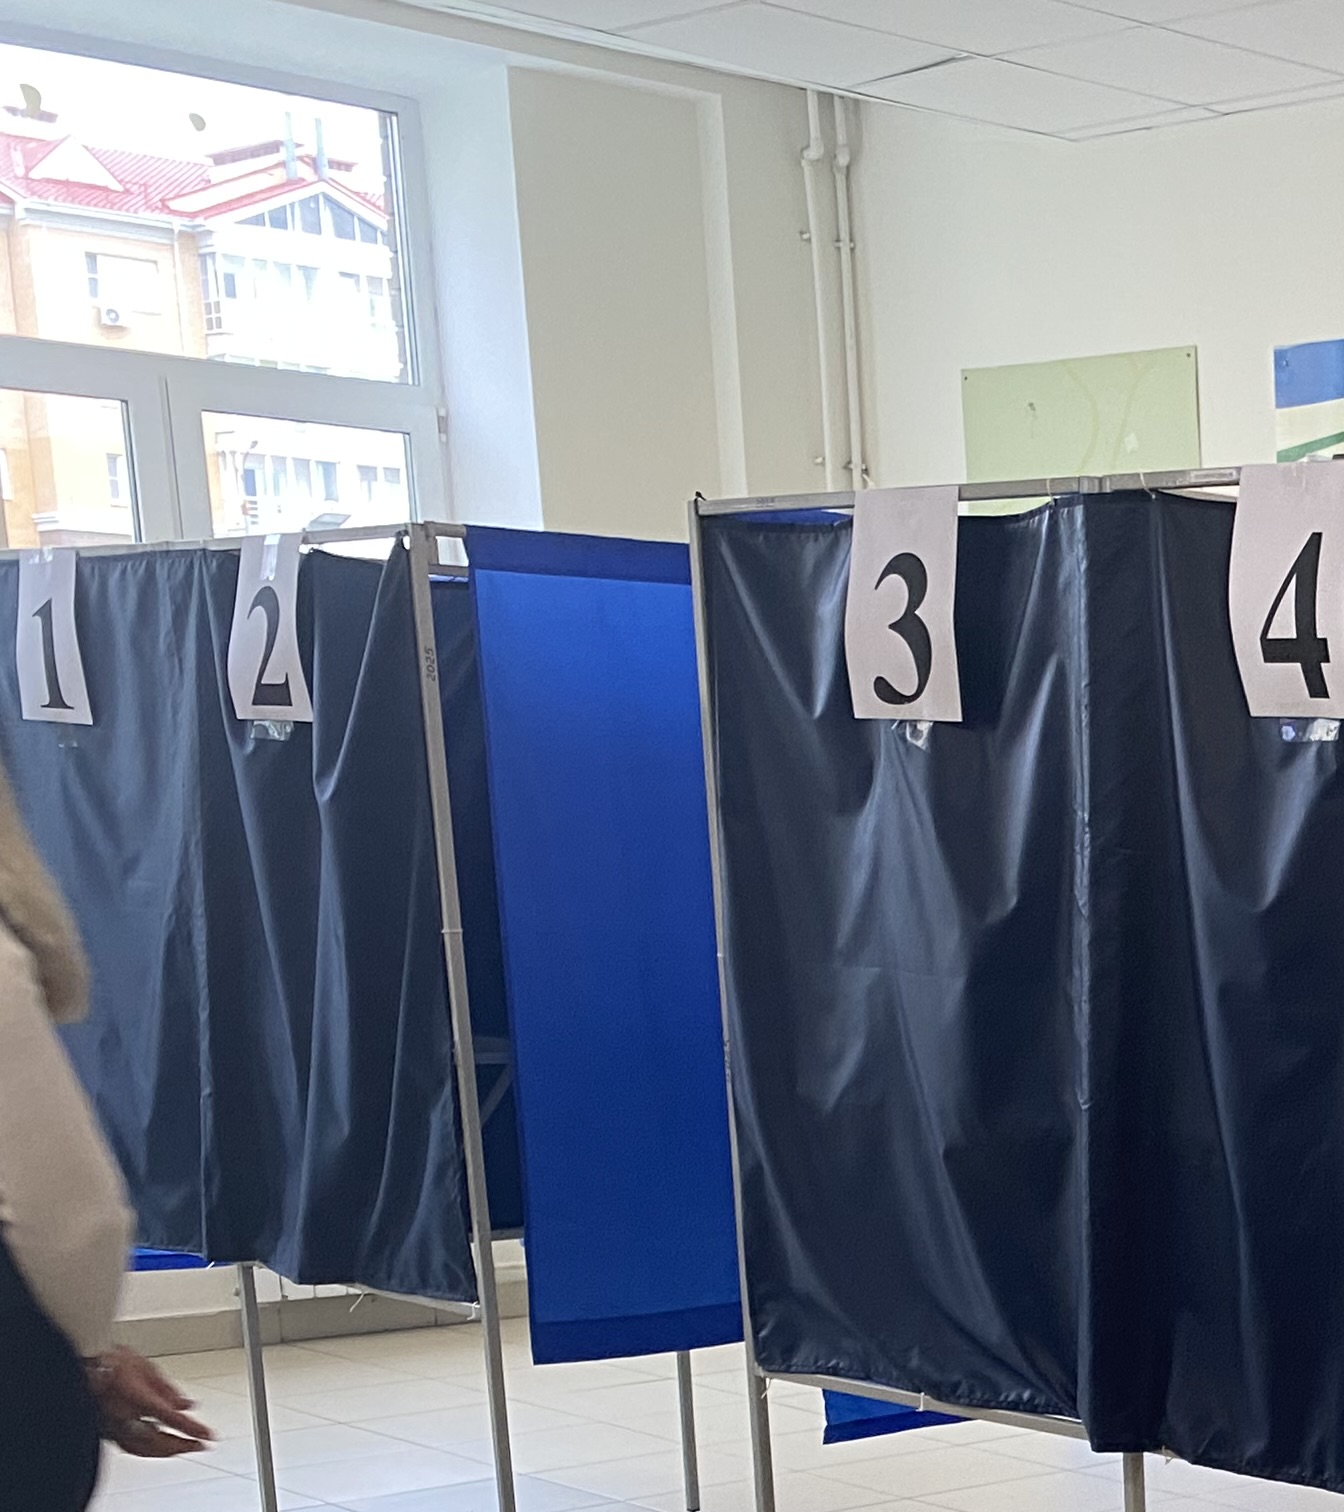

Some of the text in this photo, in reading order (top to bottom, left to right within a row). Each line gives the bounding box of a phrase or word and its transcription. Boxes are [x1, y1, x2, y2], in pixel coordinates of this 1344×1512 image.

[36, 597, 76, 711] 1
[250, 587, 296, 706] 2
[873, 552, 933, 705] 3
[1260, 532, 1330, 698] 4
